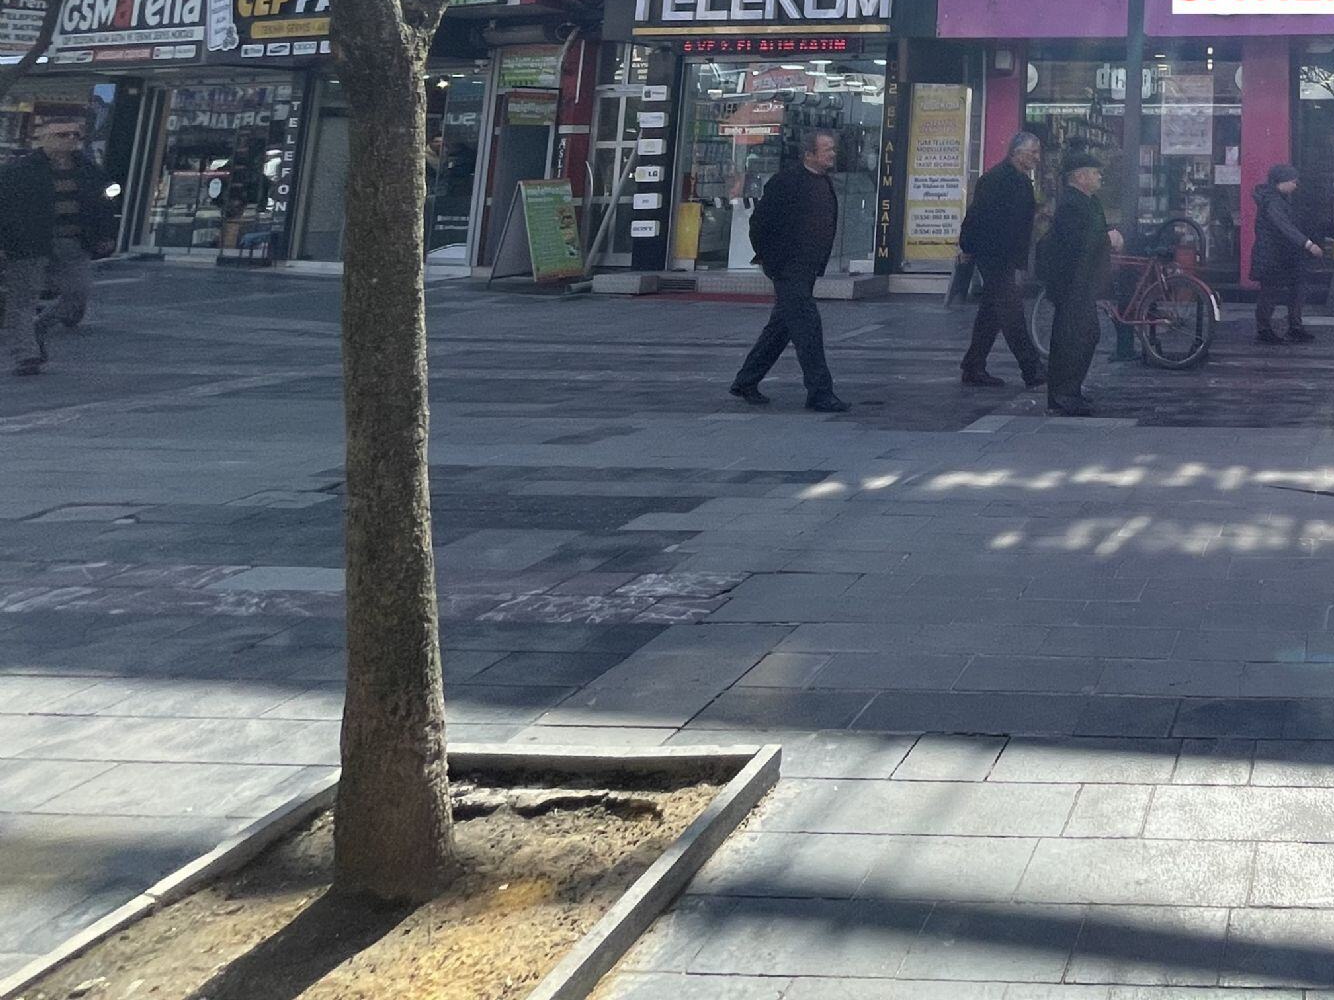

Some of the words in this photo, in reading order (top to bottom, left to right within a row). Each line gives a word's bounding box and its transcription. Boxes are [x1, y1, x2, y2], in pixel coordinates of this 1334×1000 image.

[275, 100, 301, 212] TELEFON
[883, 141, 894, 187] ALIM
[878, 199, 890, 258] SATIM
